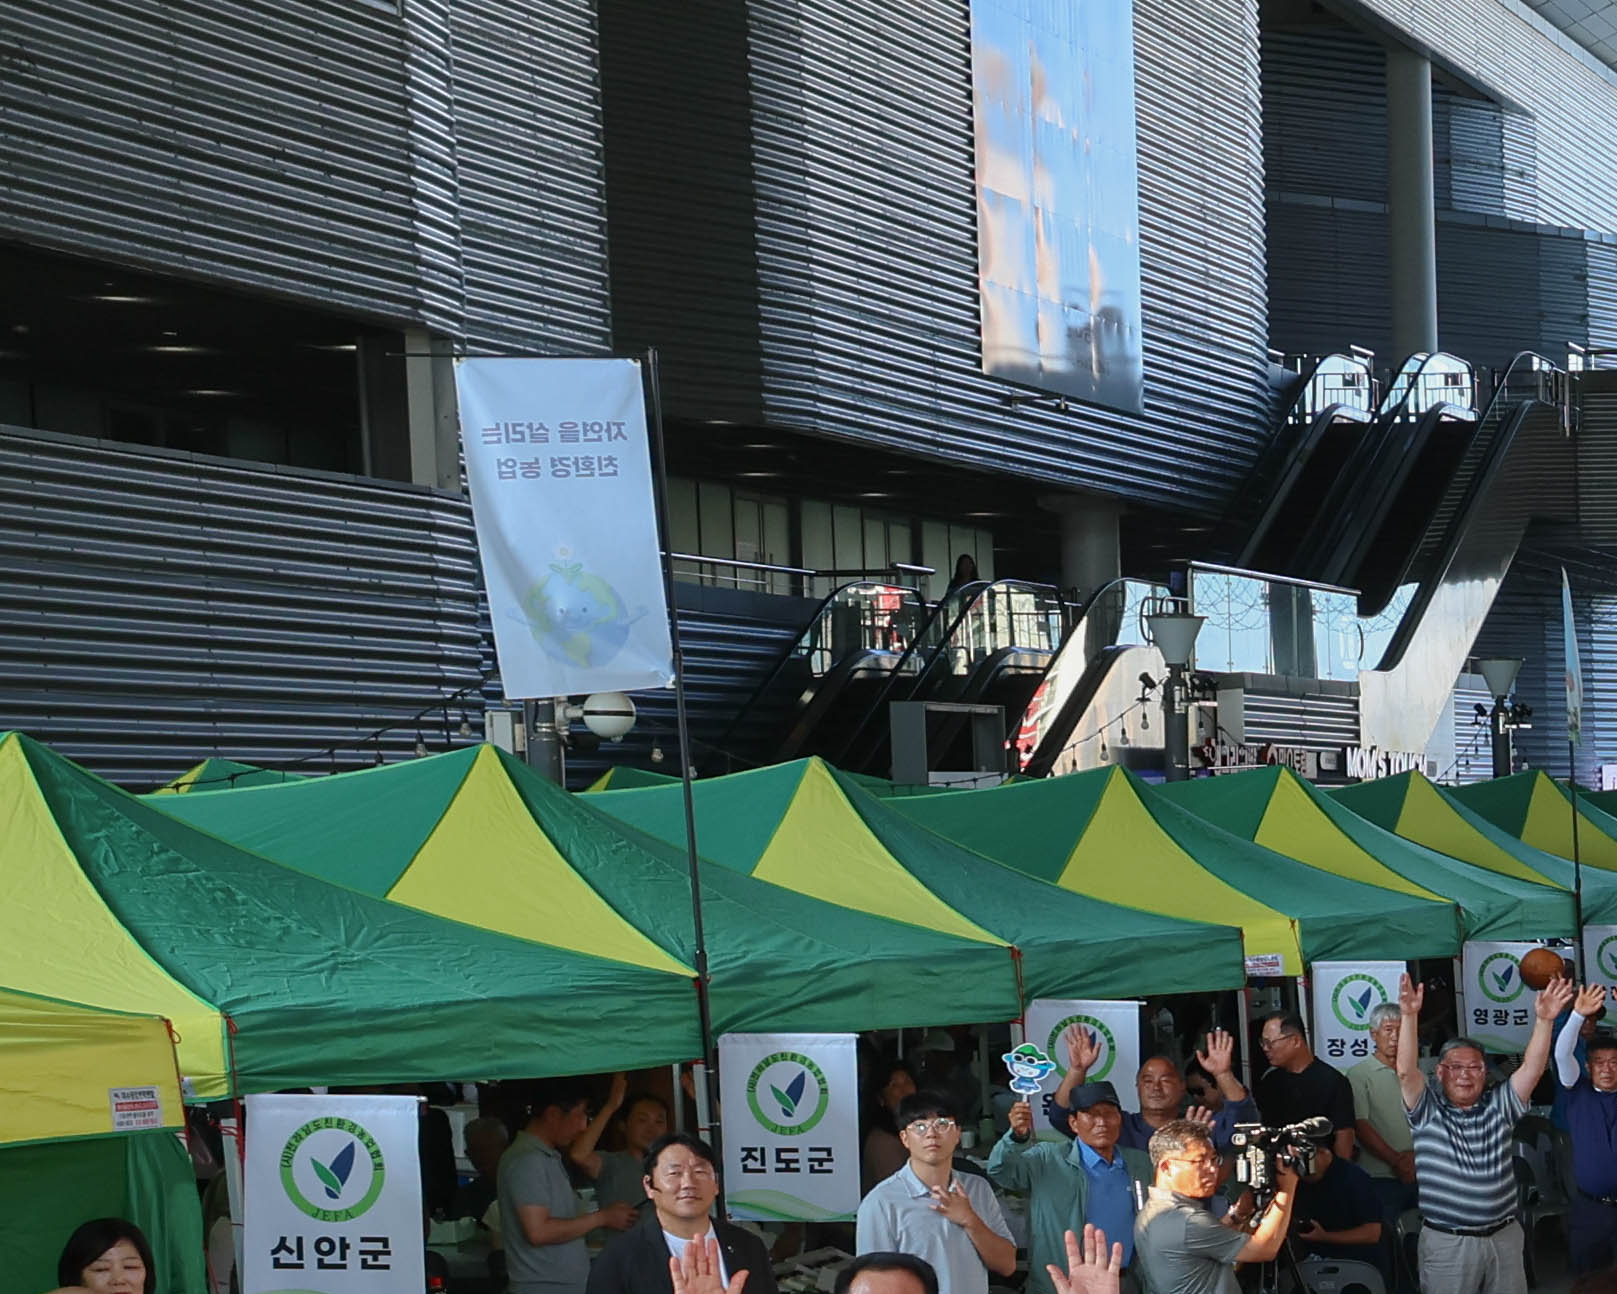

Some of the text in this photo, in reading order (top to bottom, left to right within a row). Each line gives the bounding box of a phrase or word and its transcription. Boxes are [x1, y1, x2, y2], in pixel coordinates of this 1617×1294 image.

[1473, 1008, 1529, 1026] 영광군
[1327, 1038, 1378, 1057] 장성
[740, 1146, 834, 1174] 진도군
[311, 1207, 355, 1221] JEFA
[270, 1236, 392, 1270] 신안군
